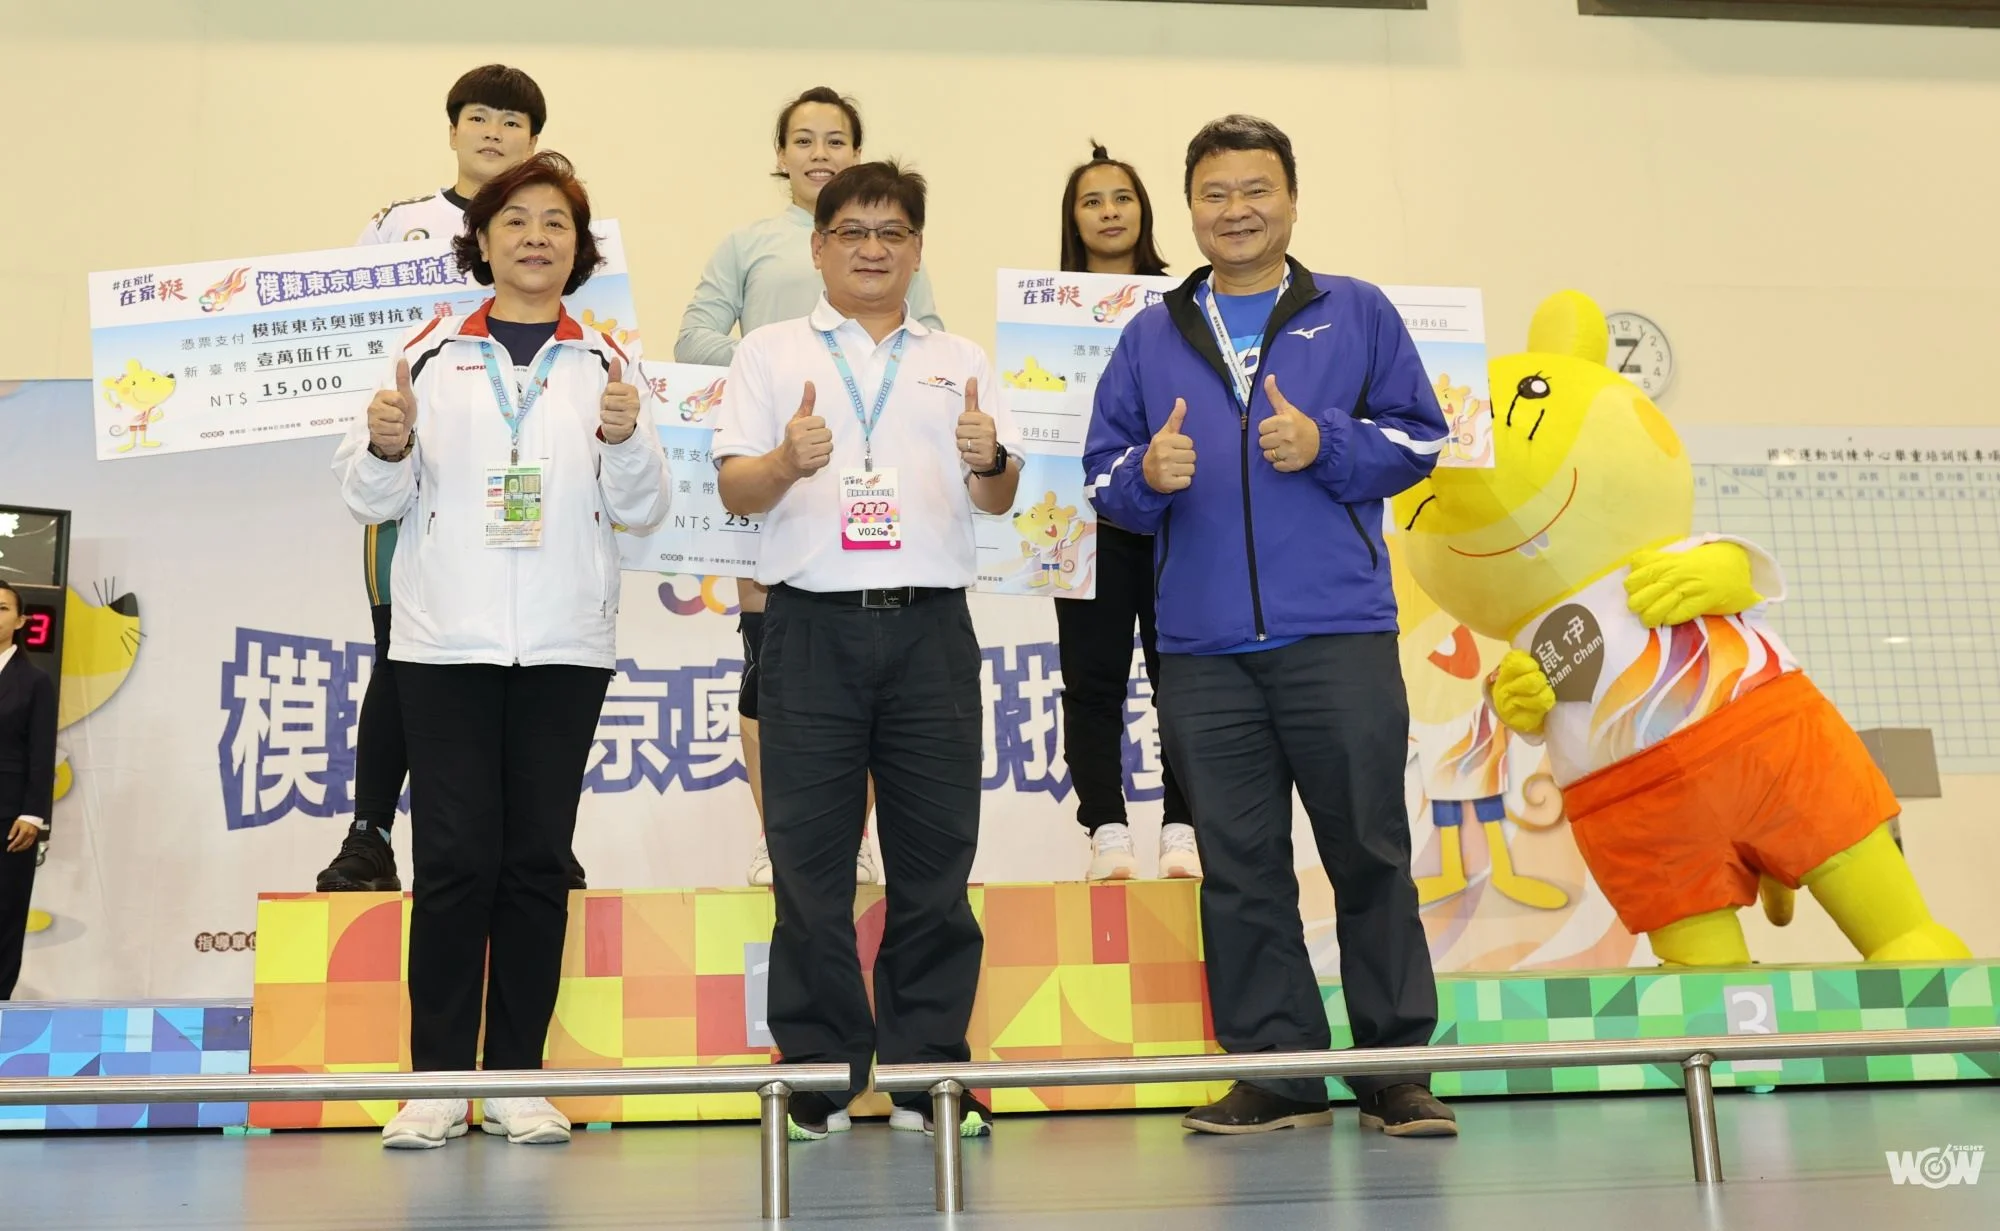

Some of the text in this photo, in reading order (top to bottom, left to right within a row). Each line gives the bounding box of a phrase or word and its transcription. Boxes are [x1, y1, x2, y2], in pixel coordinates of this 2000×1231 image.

[256, 252, 467, 306] 模擬東京奧運對抗賽
[120, 278, 188, 306] 在家挺
[252, 306, 424, 339] 模擬東京奧運對抗賽
[1620, 320, 1631, 331] 12
[1650, 335, 1657, 347] 2
[1656, 350, 1663, 362] 3
[1653, 366, 1661, 376] 4
[210, 376, 342, 408] NT$ 15,000
[1643, 377, 1651, 389] 5
[675, 513, 710, 531] NT$
[858, 527, 883, 536] V026
[26, 613, 50, 644] 3
[1535, 615, 1586, 675] 鼠伊
[1573, 635, 1603, 665] Cham
